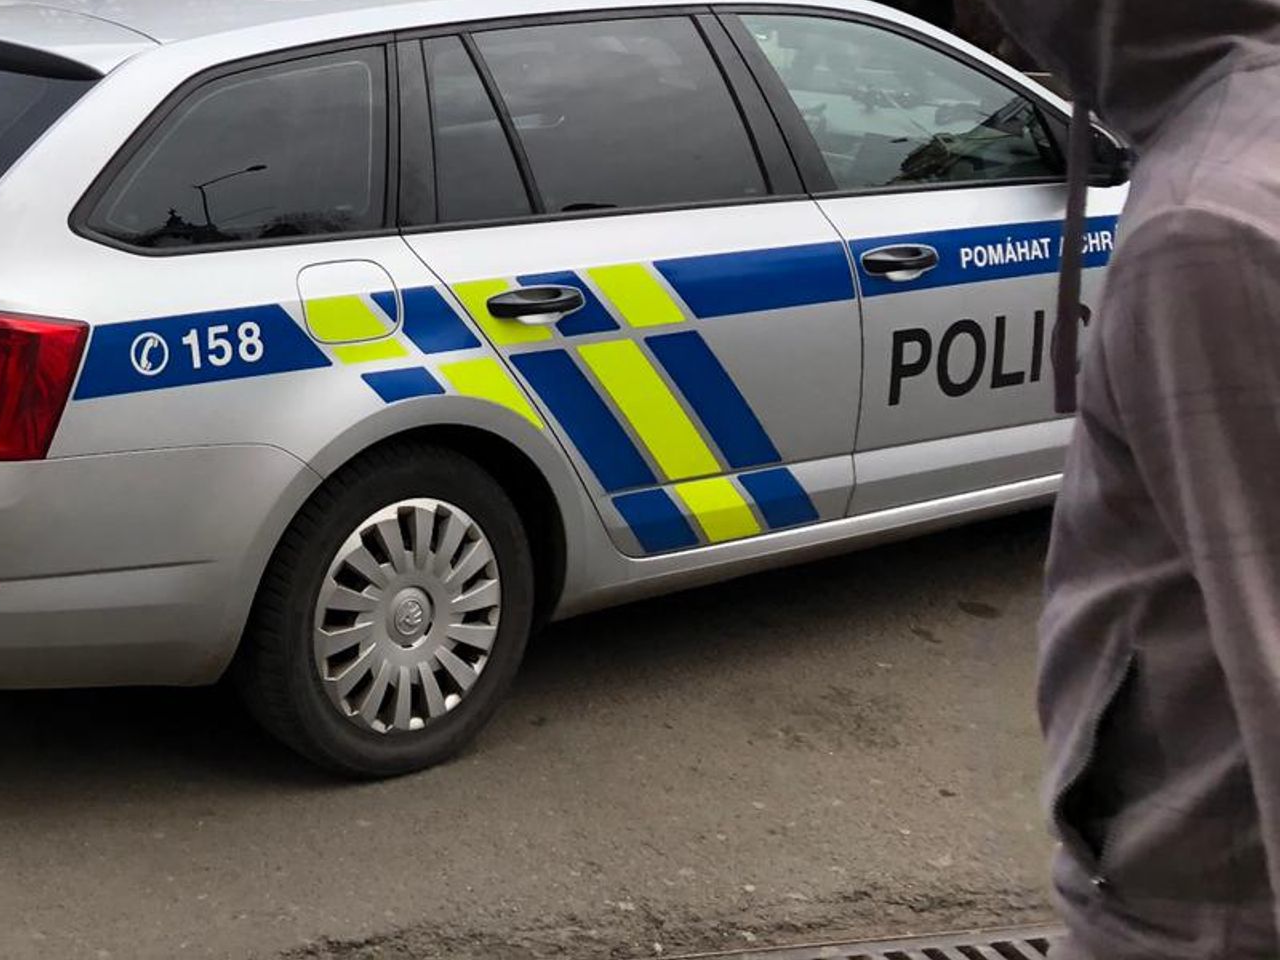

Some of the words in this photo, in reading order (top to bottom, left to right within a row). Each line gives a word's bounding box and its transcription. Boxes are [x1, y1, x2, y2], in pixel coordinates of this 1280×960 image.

[960, 237, 1051, 268] POMÁHAT
[182, 321, 264, 369] 158
[888, 309, 1091, 406] POLI
